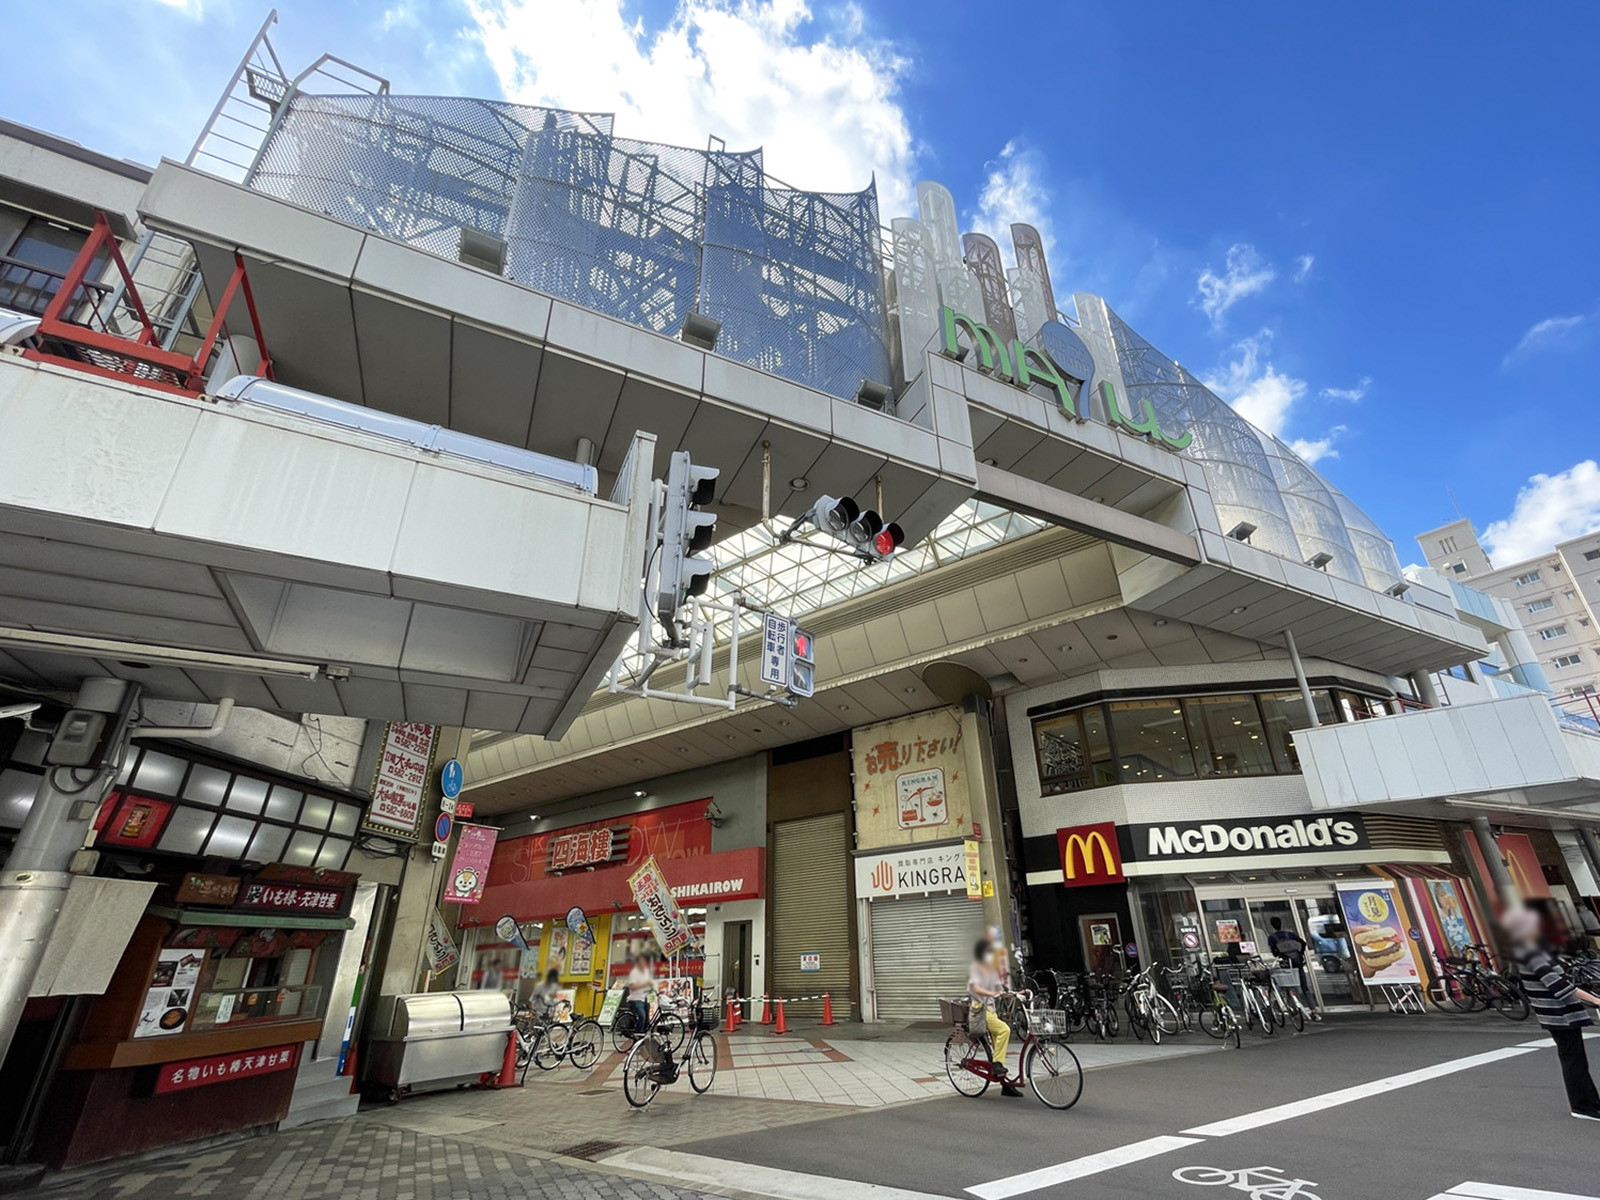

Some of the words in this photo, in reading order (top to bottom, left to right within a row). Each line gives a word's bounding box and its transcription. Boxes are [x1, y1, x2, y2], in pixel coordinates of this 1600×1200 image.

[767, 618, 776, 653] 自転車
[777, 621, 786, 656] 歩行者
[770, 655, 779, 680] 専用
[902, 775, 938, 786] KINGRAM
[552, 827, 611, 869] 四海樓
[1148, 818, 1359, 856] McDonald's
[897, 857, 934, 867] 買取専門店
[670, 878, 744, 898] SHIKAIROW
